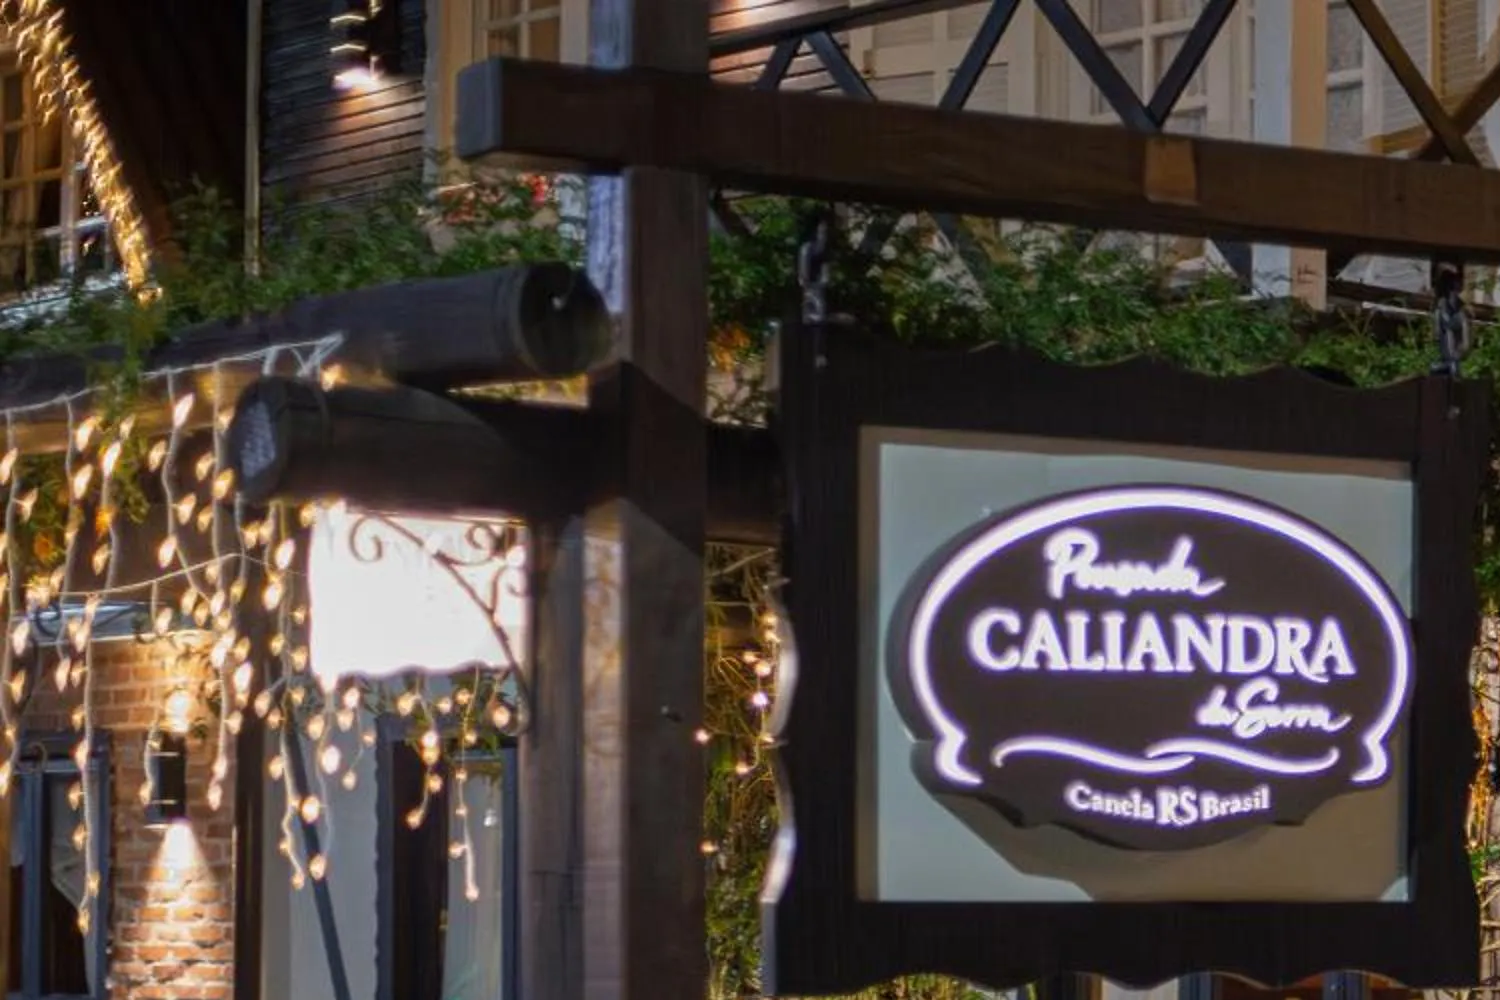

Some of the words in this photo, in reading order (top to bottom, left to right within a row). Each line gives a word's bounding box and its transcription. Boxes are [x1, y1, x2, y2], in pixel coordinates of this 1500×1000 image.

[968, 608, 1356, 683] CALIANDRA
[1064, 781, 1154, 820] Canela
[1156, 784, 1199, 826] RS
[1201, 784, 1271, 821] Brasil
